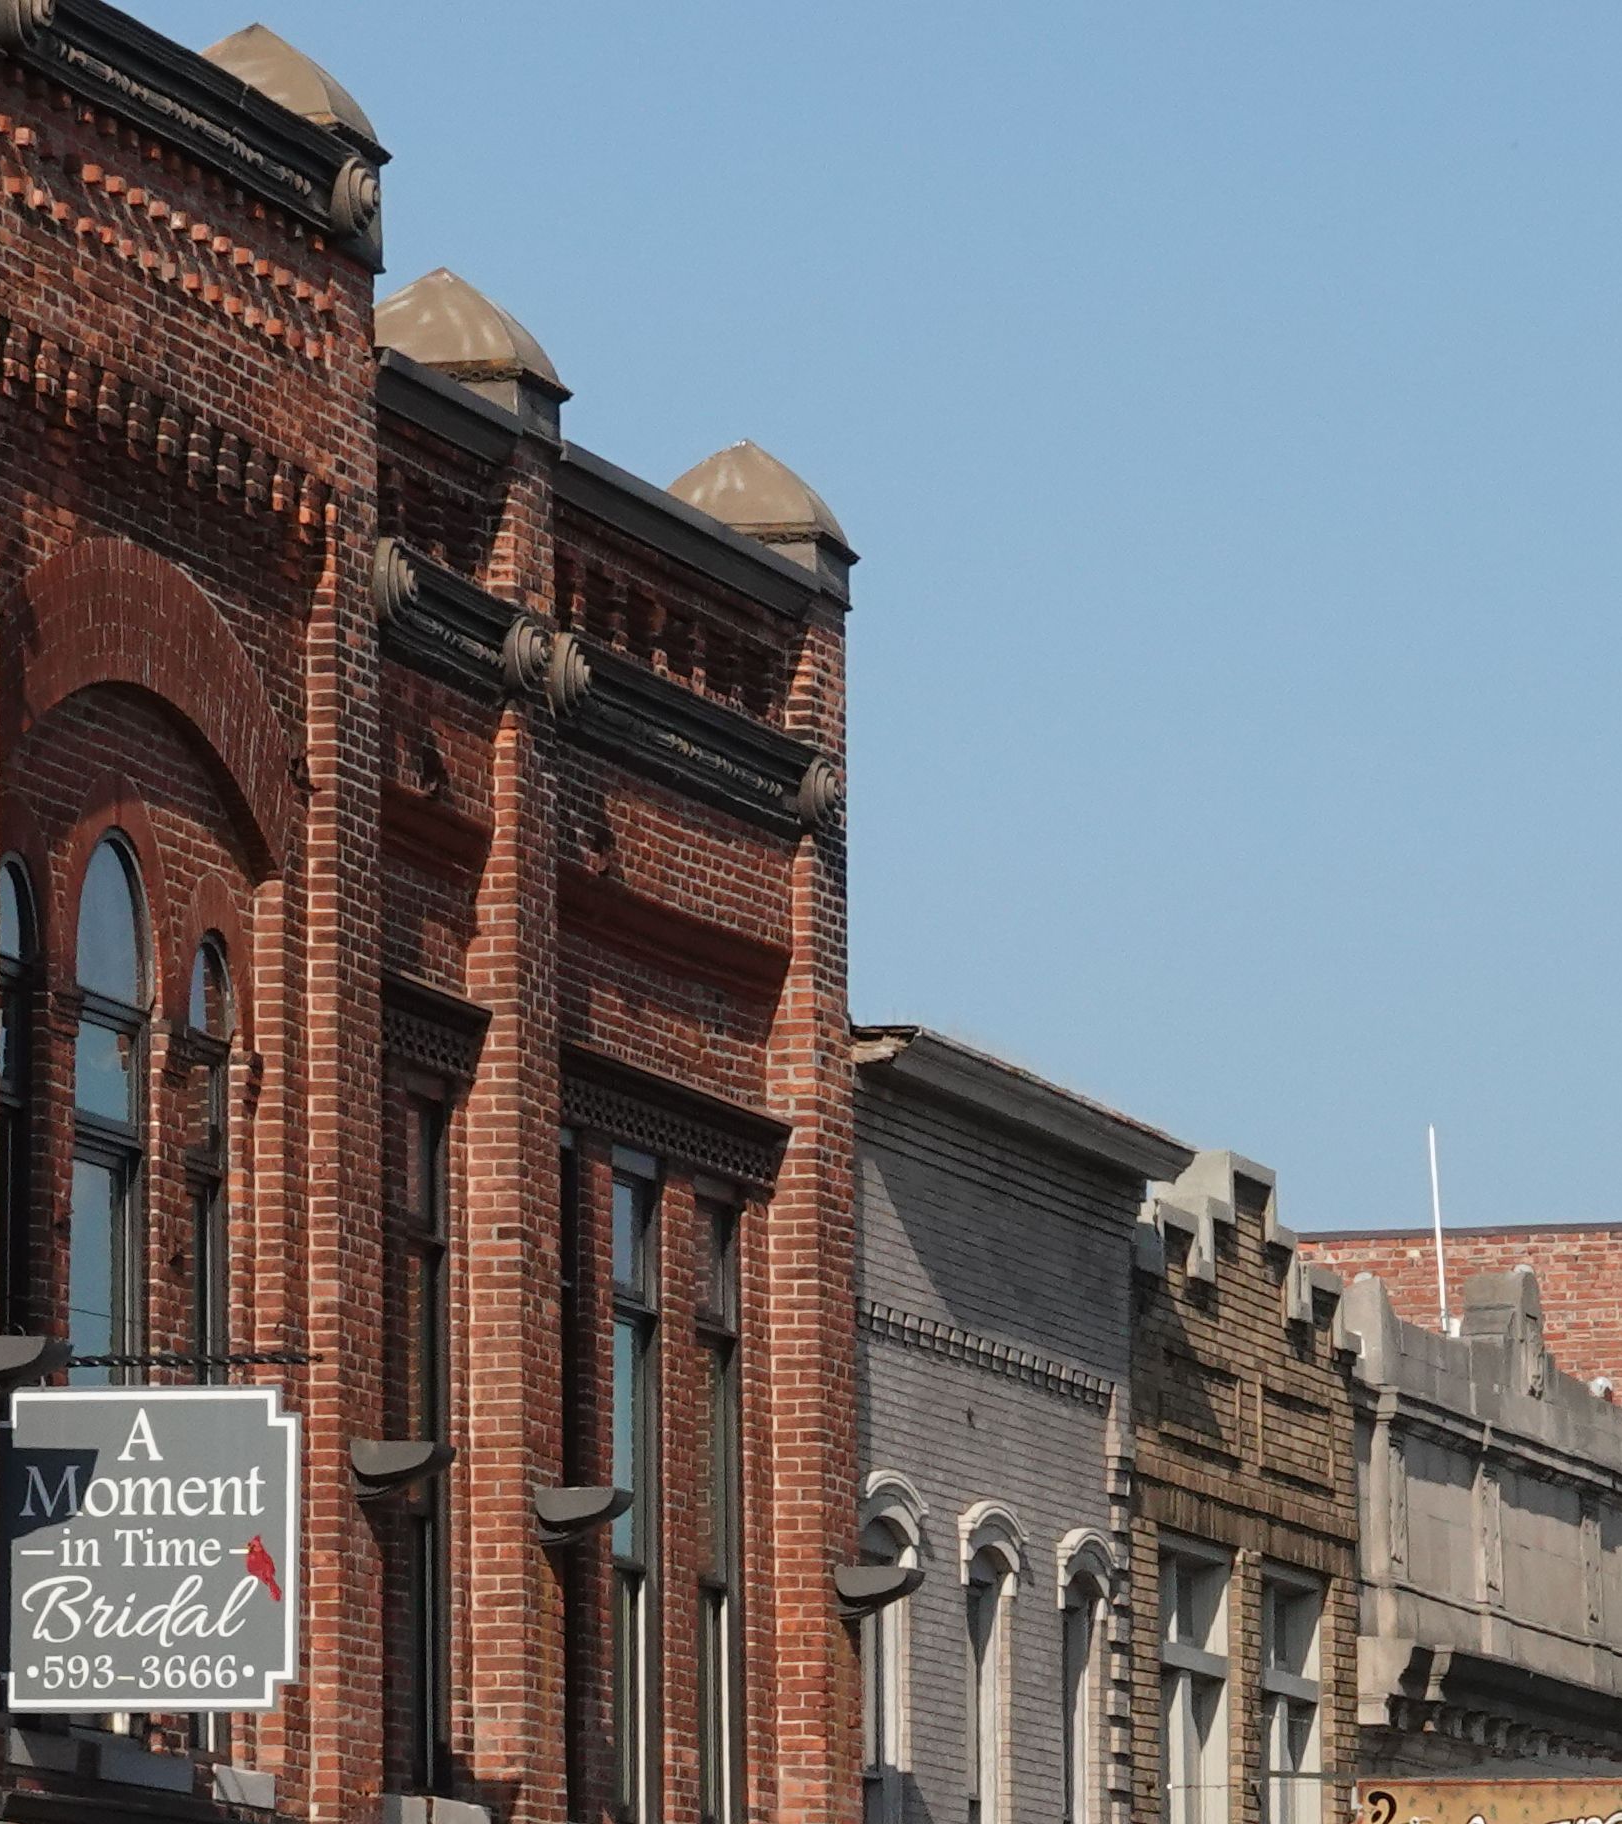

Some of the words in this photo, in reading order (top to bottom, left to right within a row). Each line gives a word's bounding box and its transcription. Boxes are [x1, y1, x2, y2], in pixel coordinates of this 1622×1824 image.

[117, 1408, 163, 1461] A
[19, 1465, 266, 1517] Moment
[59, 1528, 102, 1567] in
[114, 1527, 222, 1567] Time
[21, 1575, 259, 1648] Bridal
[43, 1655, 238, 1690] 593-3666
